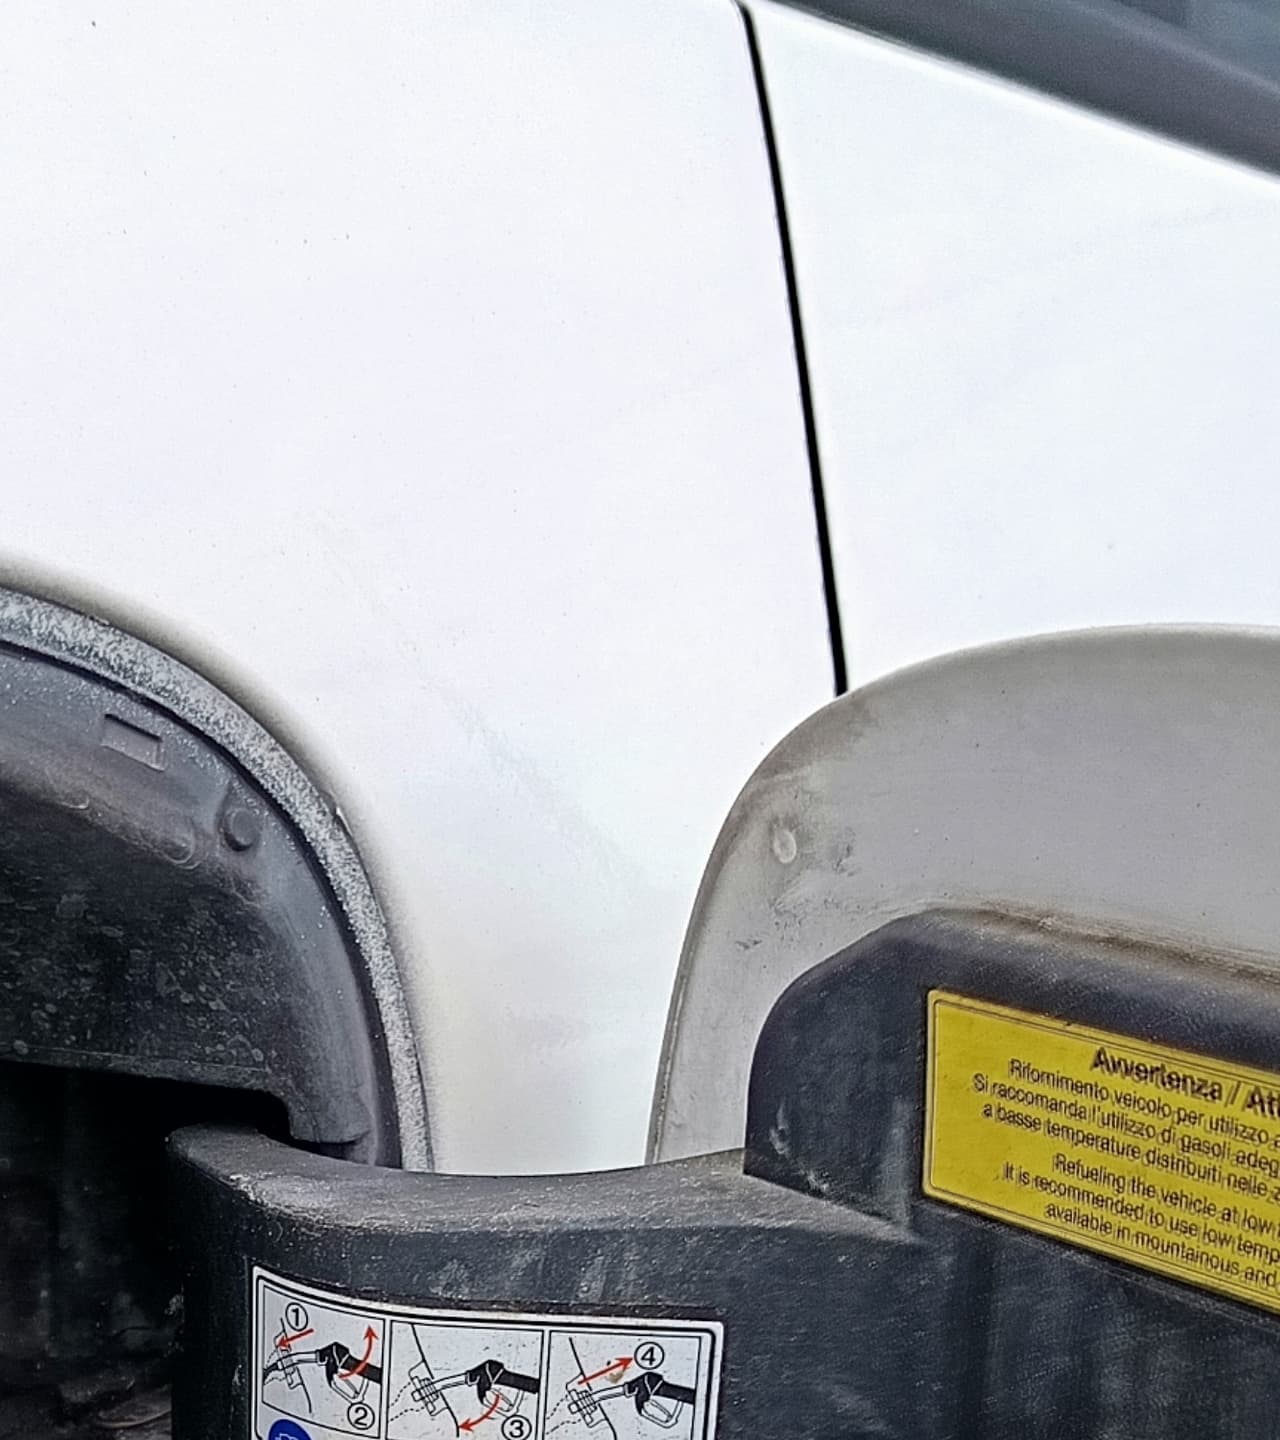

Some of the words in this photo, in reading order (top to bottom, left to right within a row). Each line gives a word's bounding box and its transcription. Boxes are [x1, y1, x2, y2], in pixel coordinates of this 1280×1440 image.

[973, 1072, 988, 1093] Si
[992, 1082, 1087, 1121] raccomanda
[1091, 1105, 1156, 1141] l'utilizzo
[1160, 1124, 1177, 1147] di
[1179, 1134, 1231, 1162] gasoli
[1009, 1057, 1109, 1102] Rifornimento
[1112, 1090, 1172, 1119] veicolo
[1174, 1106, 1204, 1128] per
[1208, 1113, 1269, 1145] utilizzo
[1091, 1046, 1222, 1100] Avvertenza
[982, 1103, 993, 1119] a
[996, 1103, 1041, 1133] basse
[1045, 1117, 1140, 1163] temperature
[1144, 1146, 1222, 1186] distribuiti
[1226, 1174, 1267, 1200] nelle
[1054, 1152, 1125, 1195] Refueling
[1130, 1175, 1156, 1200] the
[1159, 1188, 1217, 1219] vehicle
[1220, 1205, 1239, 1226] at
[1242, 1209, 1272, 1236] low
[1003, 1160, 1014, 1180] It
[1017, 1164, 1030, 1185] is
[1034, 1174, 1144, 1221] recommended
[1148, 1205, 1164, 1228] to
[1169, 1217, 1198, 1239] use
[1202, 1222, 1232, 1250] low
[1045, 1201, 1112, 1233] available
[1115, 1219, 1130, 1241] in
[1134, 1230, 1240, 1275] mountainous
[1243, 1266, 1277, 1290] and
